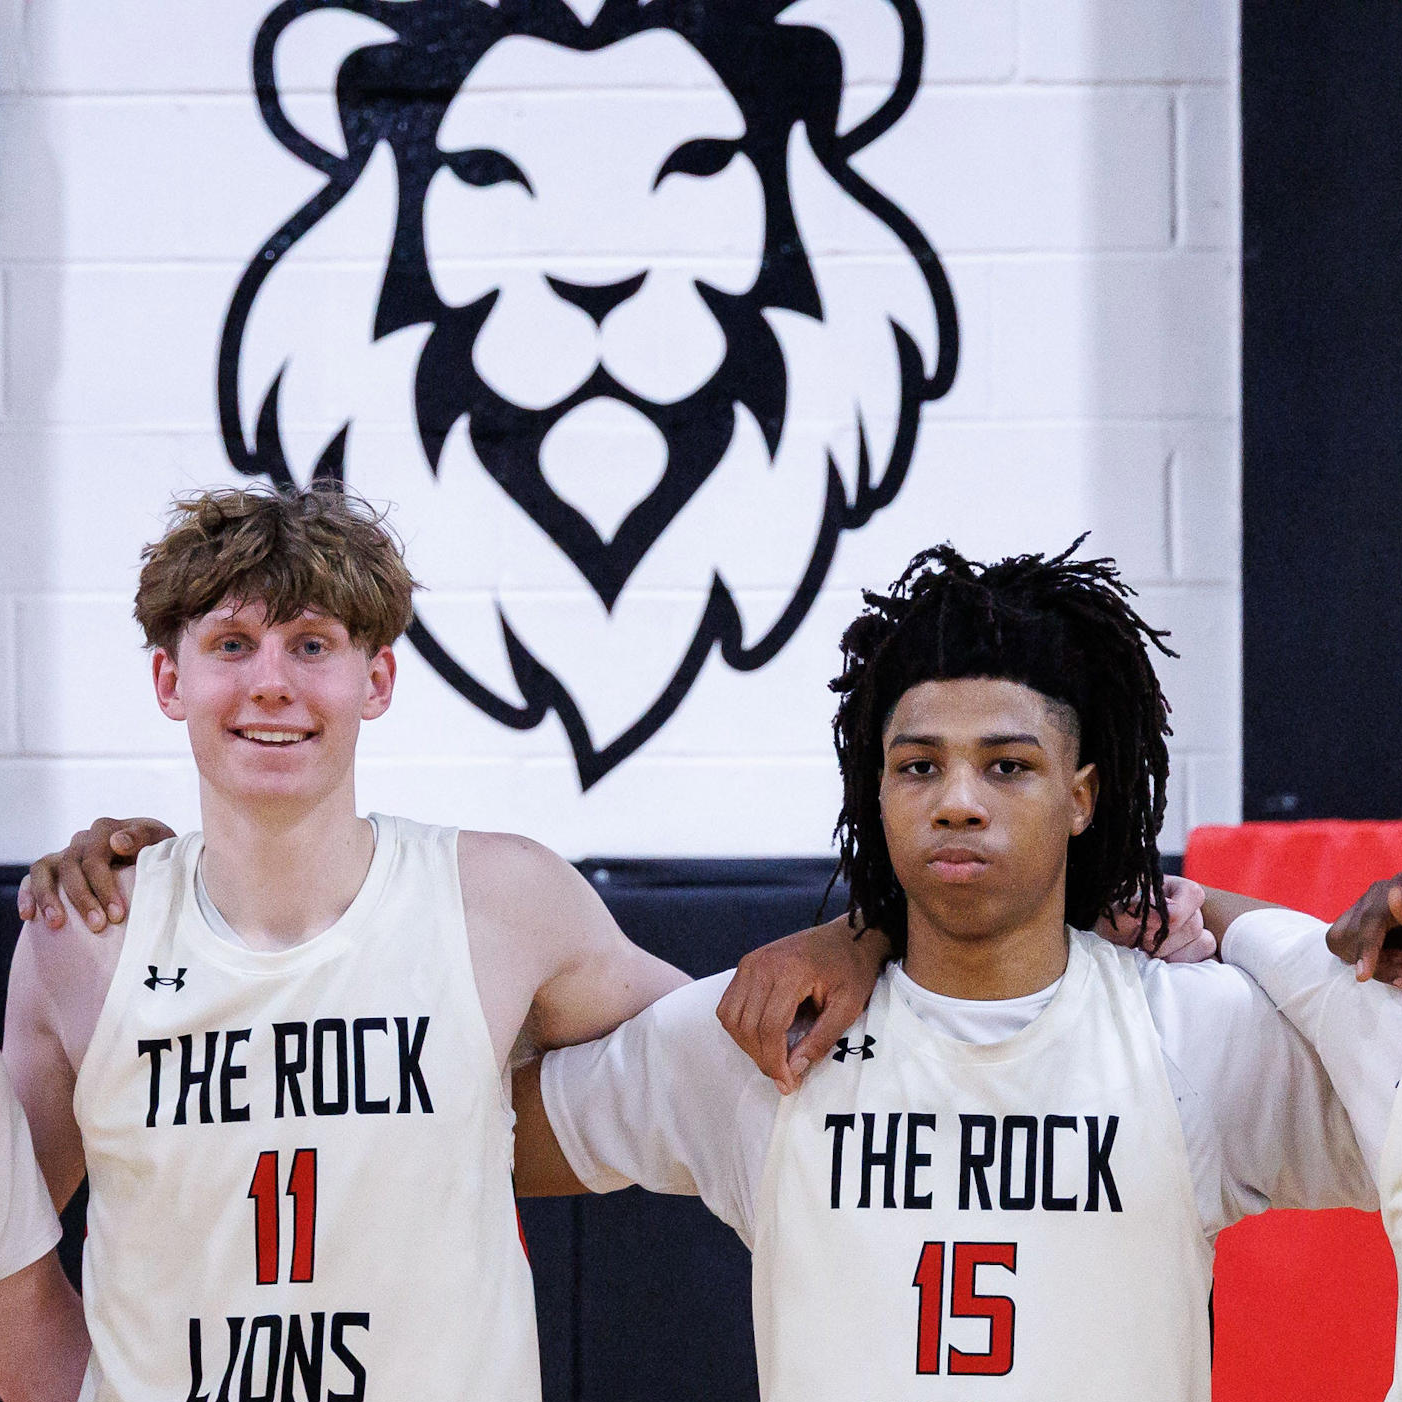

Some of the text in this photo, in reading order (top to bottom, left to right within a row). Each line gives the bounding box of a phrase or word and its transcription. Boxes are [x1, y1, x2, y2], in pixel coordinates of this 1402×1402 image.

[138, 1017, 434, 1127] THE ROCK
[248, 1148, 317, 1285] 11
[825, 1113, 1122, 1212] THE ROCK
[912, 1242, 1017, 1376] 15
